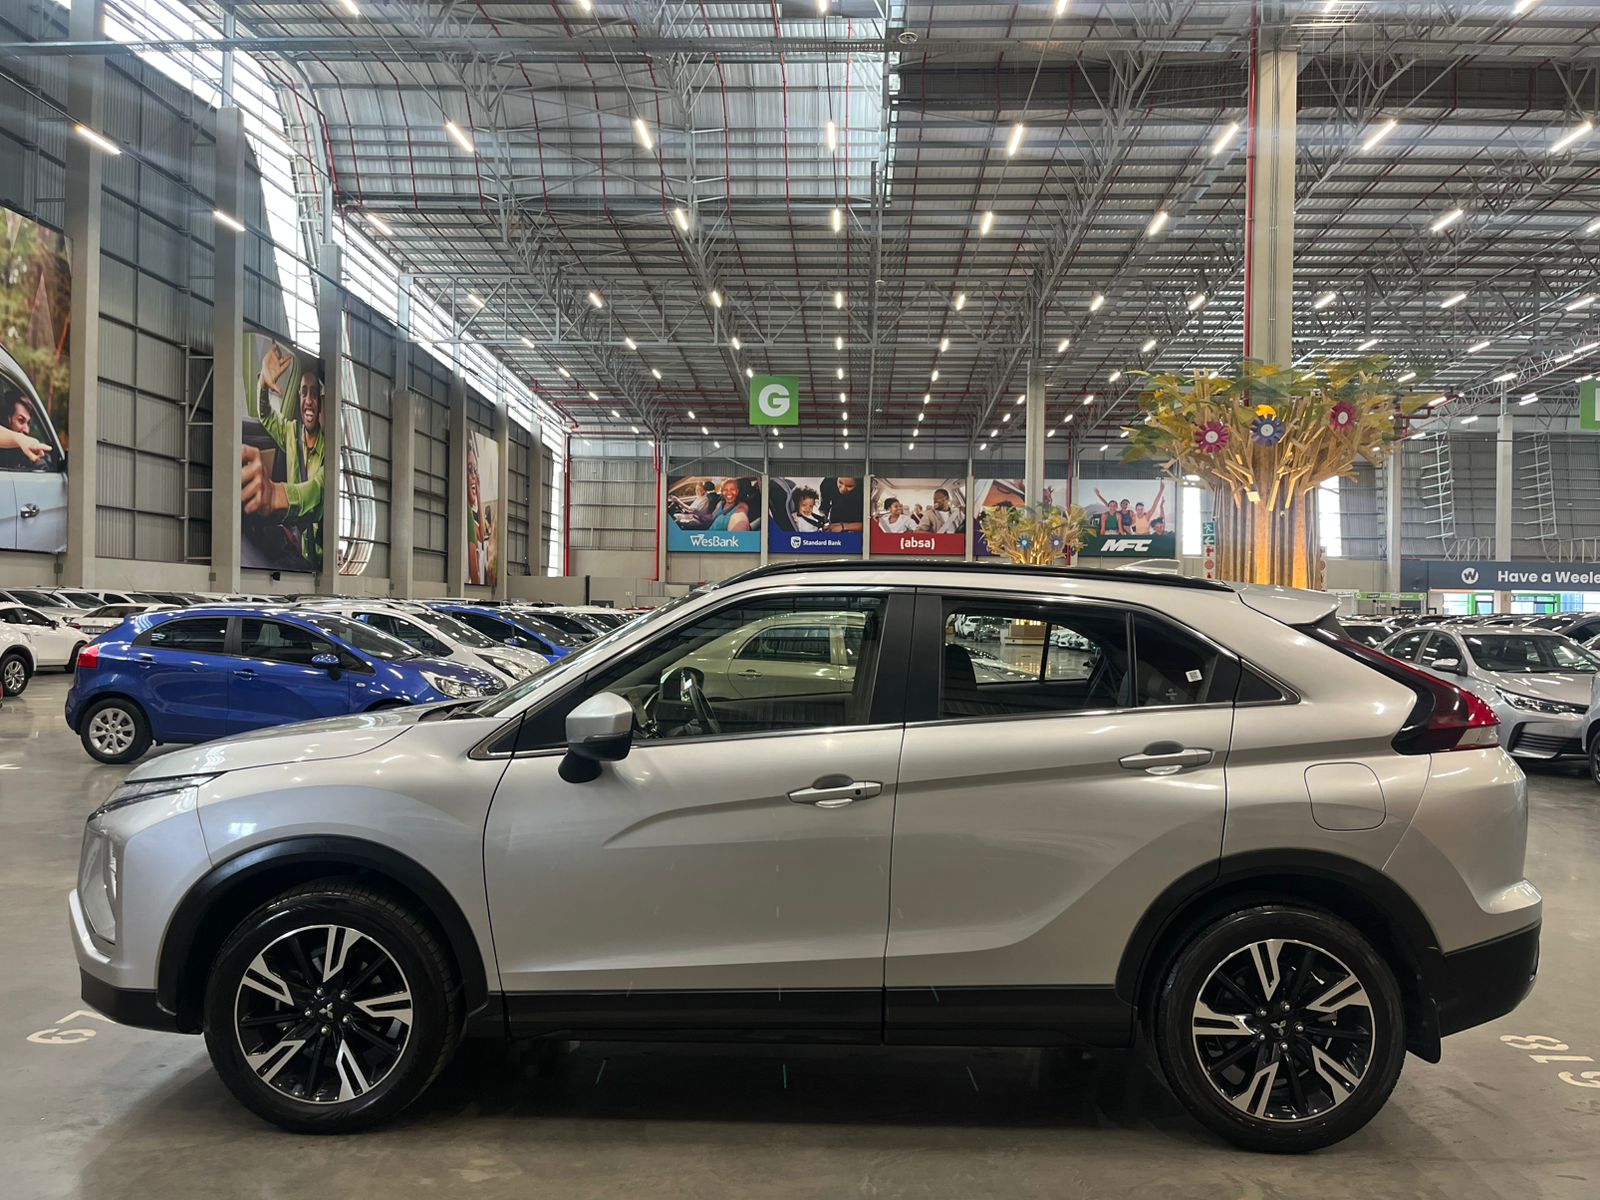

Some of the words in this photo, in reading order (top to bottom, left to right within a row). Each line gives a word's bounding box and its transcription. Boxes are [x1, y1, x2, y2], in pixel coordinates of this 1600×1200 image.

[758, 383, 790, 417] G
[690, 534, 739, 547] WesBank
[900, 537, 935, 550] (absa)
[1101, 539, 1152, 551] MFC
[1498, 570, 1538, 583] Have
[1541, 573, 1551, 583] a
